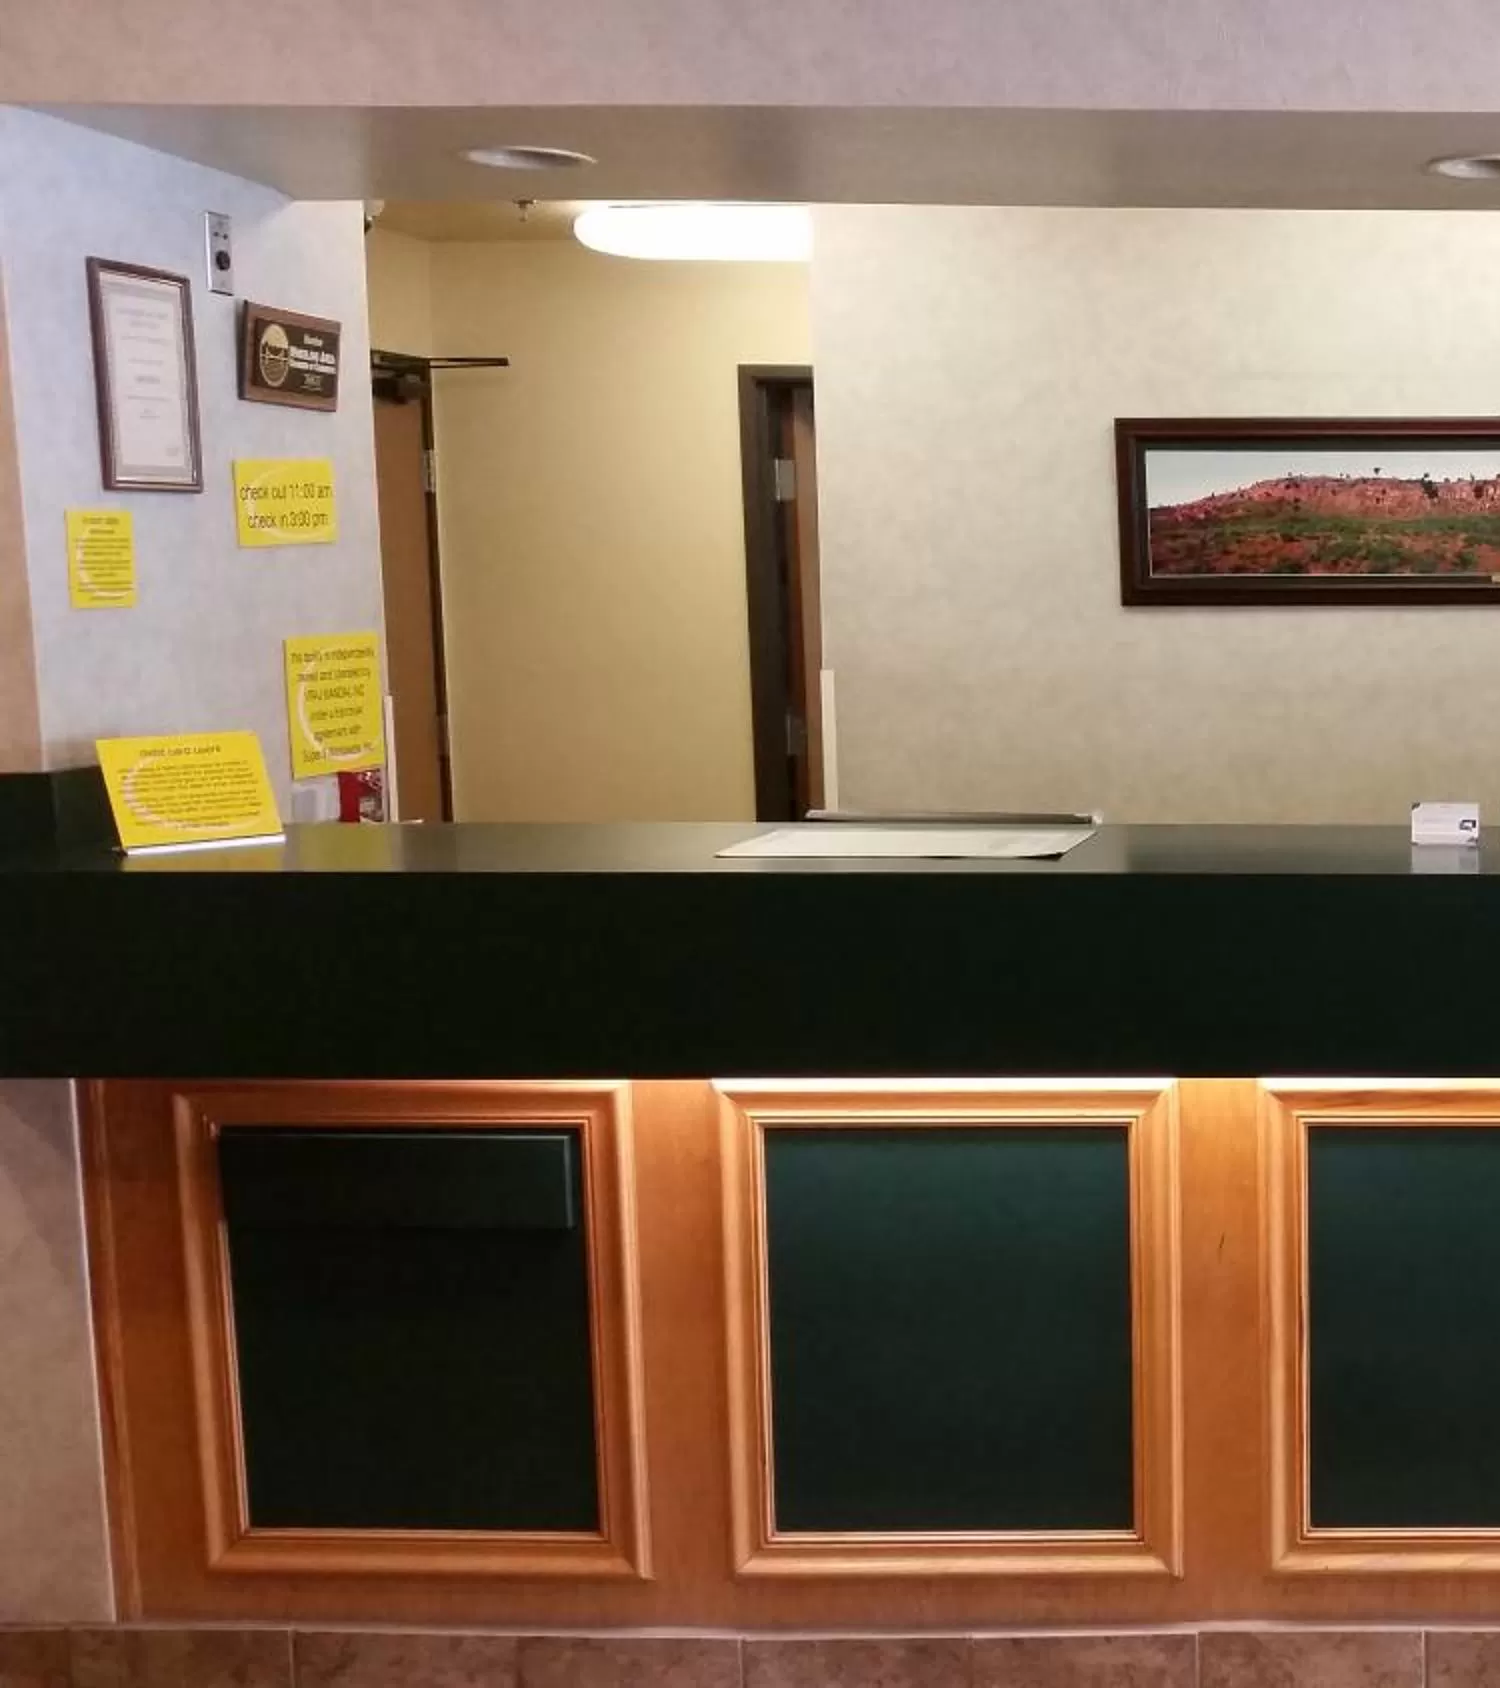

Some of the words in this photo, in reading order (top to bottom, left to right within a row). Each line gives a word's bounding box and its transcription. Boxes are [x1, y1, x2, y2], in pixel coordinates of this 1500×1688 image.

[240, 483, 269, 500] check
[271, 484, 286, 499] out
[289, 483, 315, 498] 11:00
[316, 486, 332, 498] am
[248, 513, 277, 528] check
[280, 513, 288, 526] in
[289, 511, 310, 526] 3:00
[312, 513, 329, 528] pm
